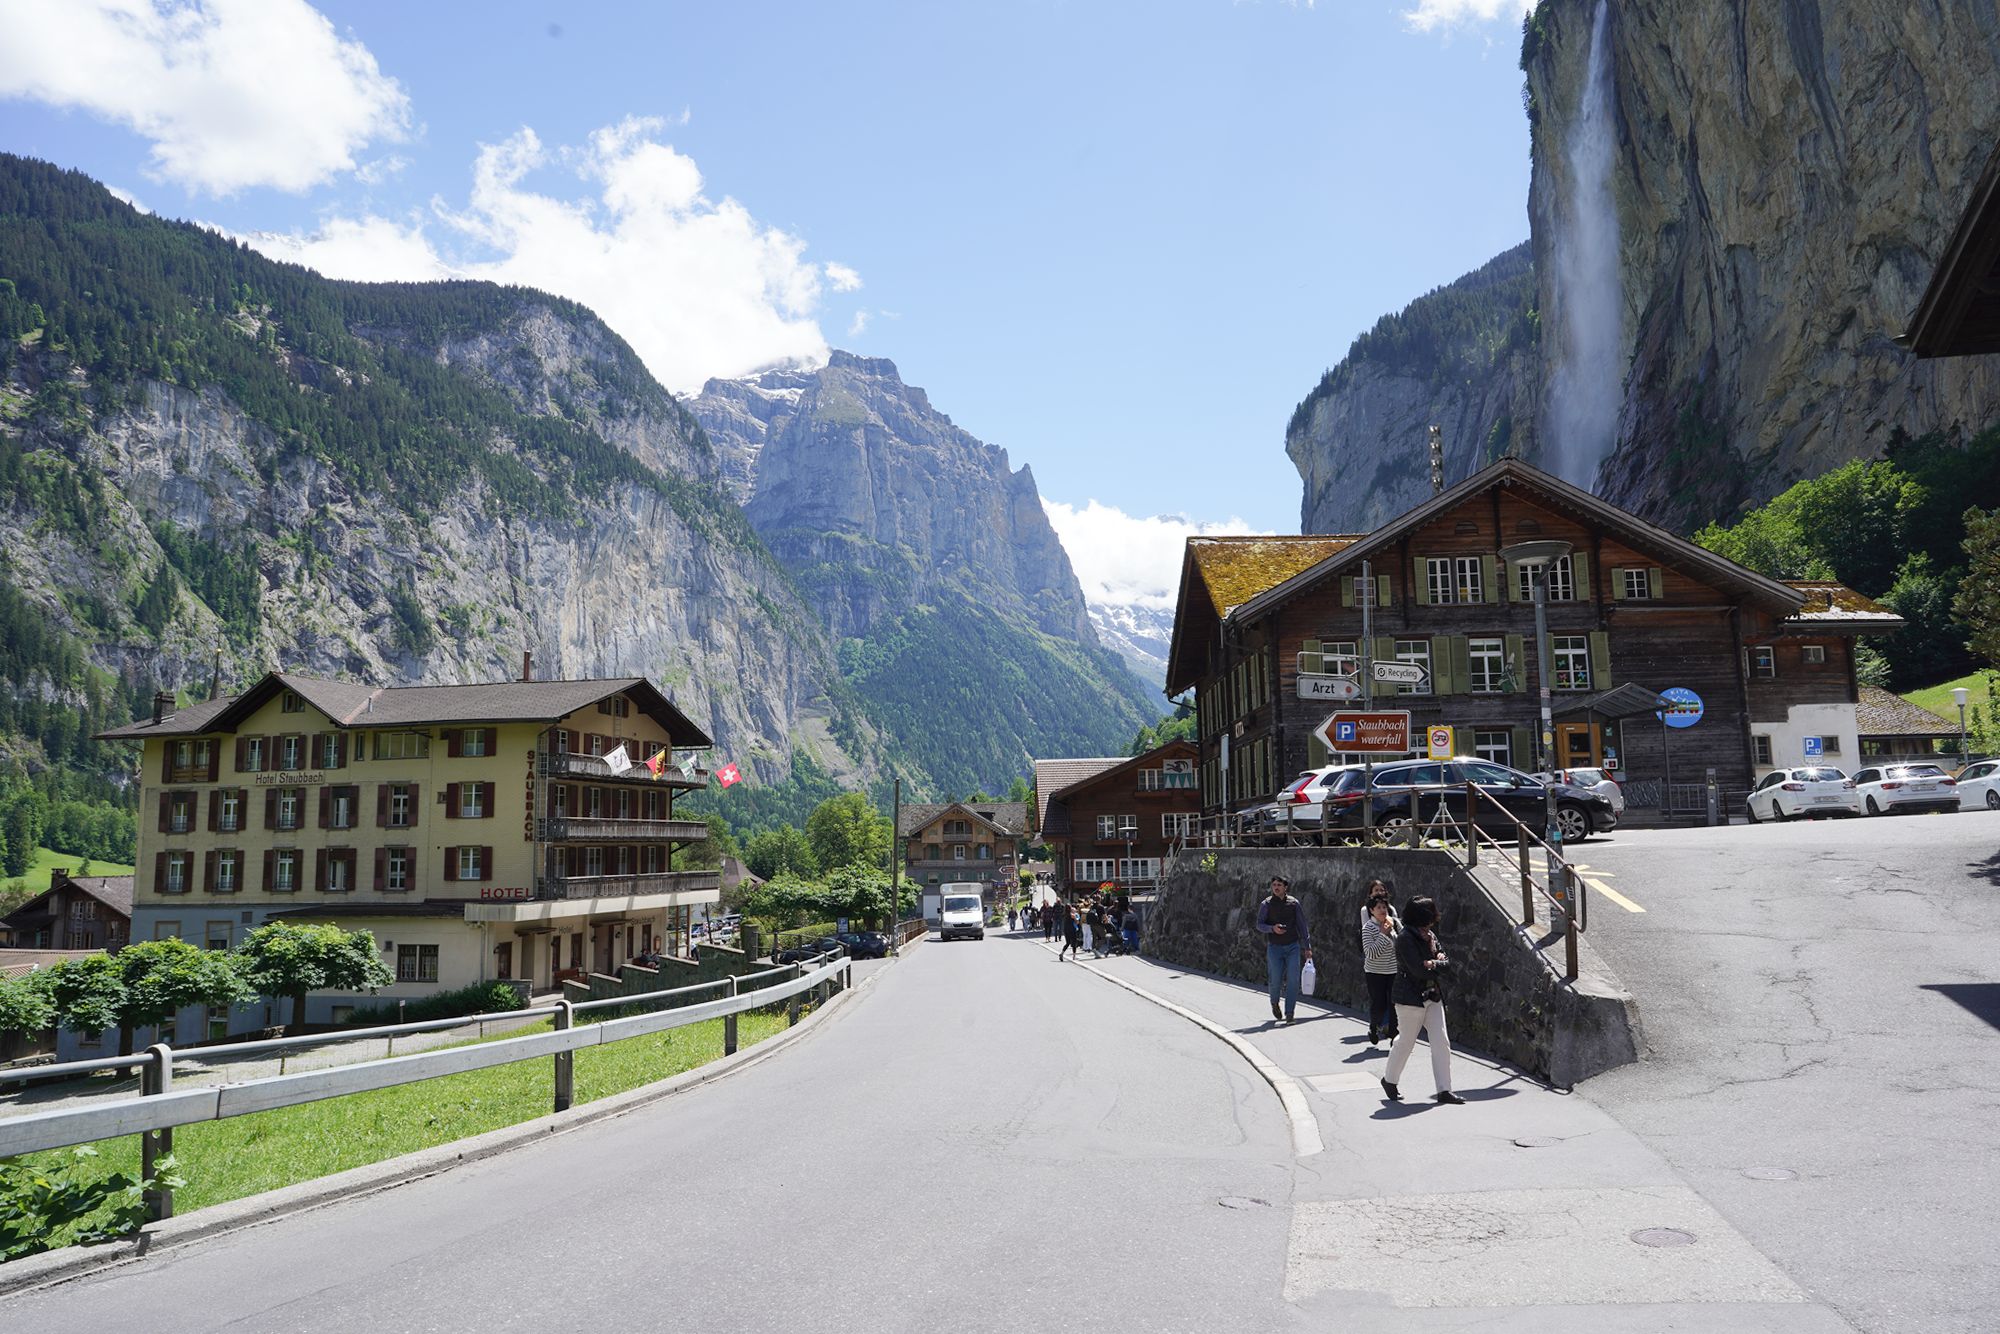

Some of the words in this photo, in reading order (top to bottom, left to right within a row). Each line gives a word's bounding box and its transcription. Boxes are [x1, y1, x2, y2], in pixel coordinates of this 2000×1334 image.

[1388, 668, 1417, 679] Recycling
[1312, 682, 1335, 694] Arzt
[1357, 719, 1405, 730] Staubbach
[1341, 725, 1351, 739] P
[1361, 734, 1401, 747] waterfall
[1806, 739, 1815, 752] P
[256, 773, 277, 784] Hotel
[279, 771, 323, 784] Staubbach
[524, 750, 535, 842] STAUBBACH
[481, 888, 531, 899] HOTEL
